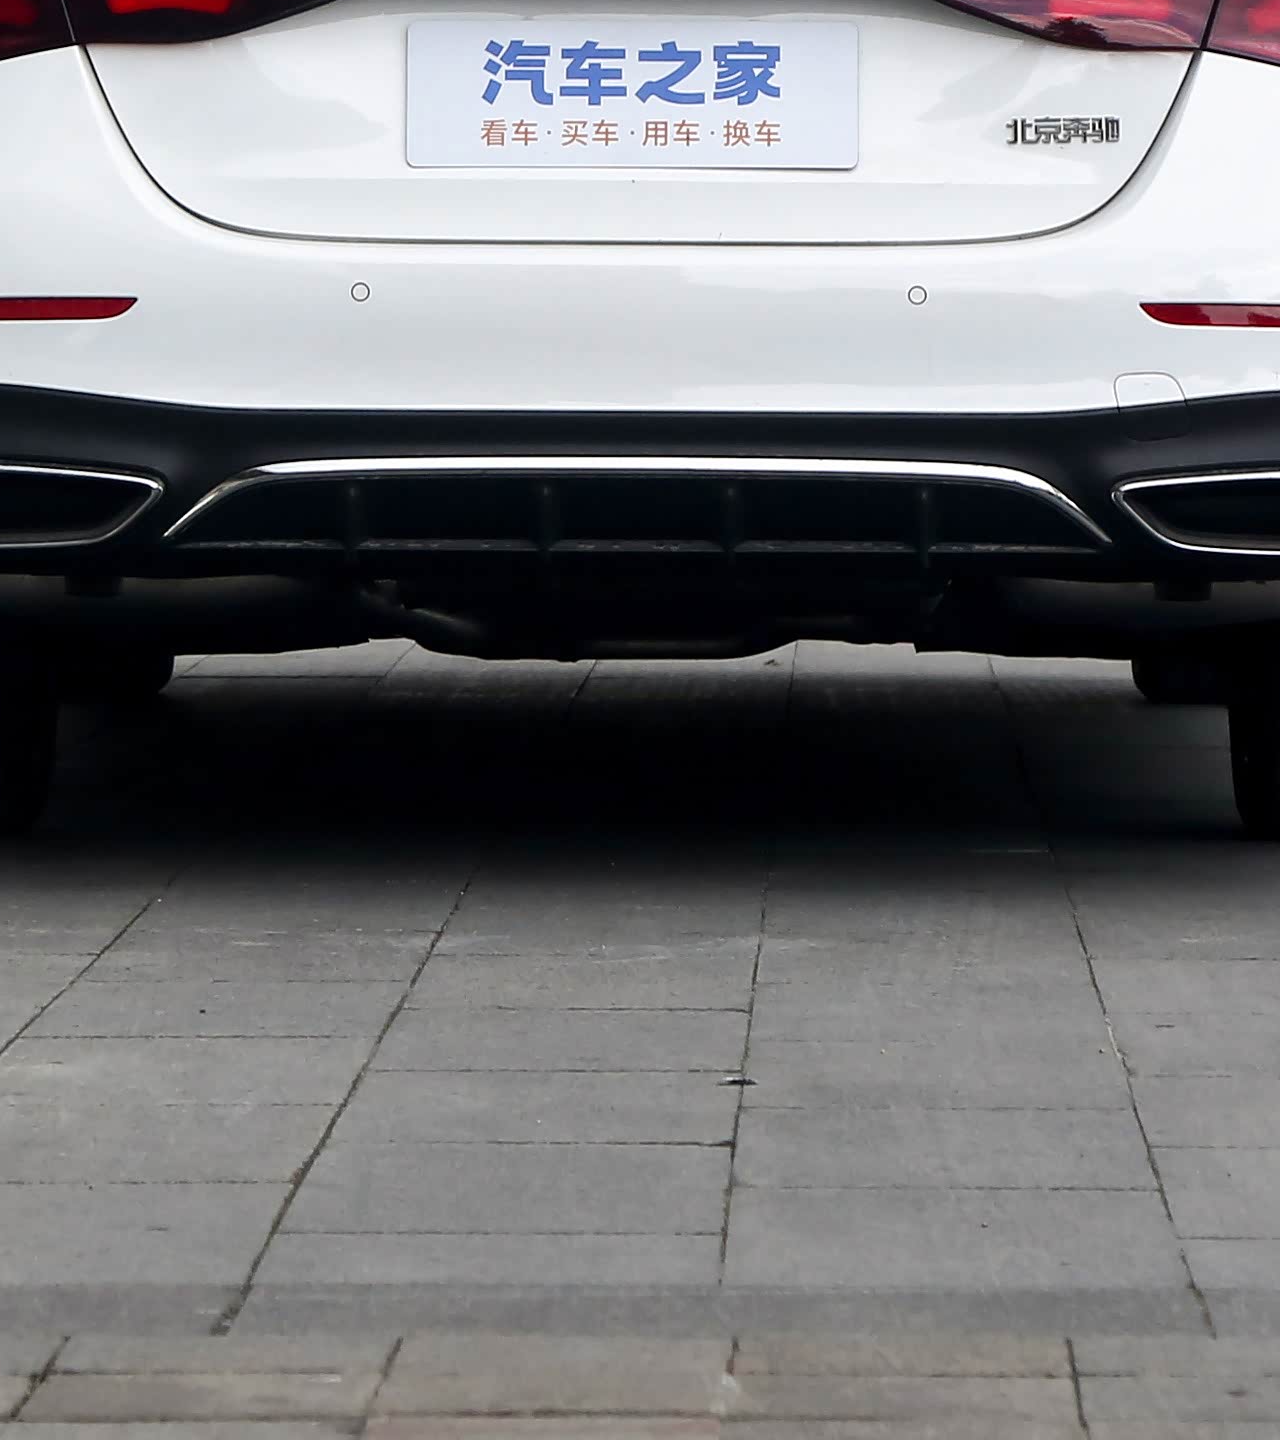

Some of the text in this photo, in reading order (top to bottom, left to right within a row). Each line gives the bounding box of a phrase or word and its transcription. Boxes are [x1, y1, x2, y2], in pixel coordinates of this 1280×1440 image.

[480, 39, 782, 107] 汽车之家
[1005, 116, 1120, 145] 北京奔驰
